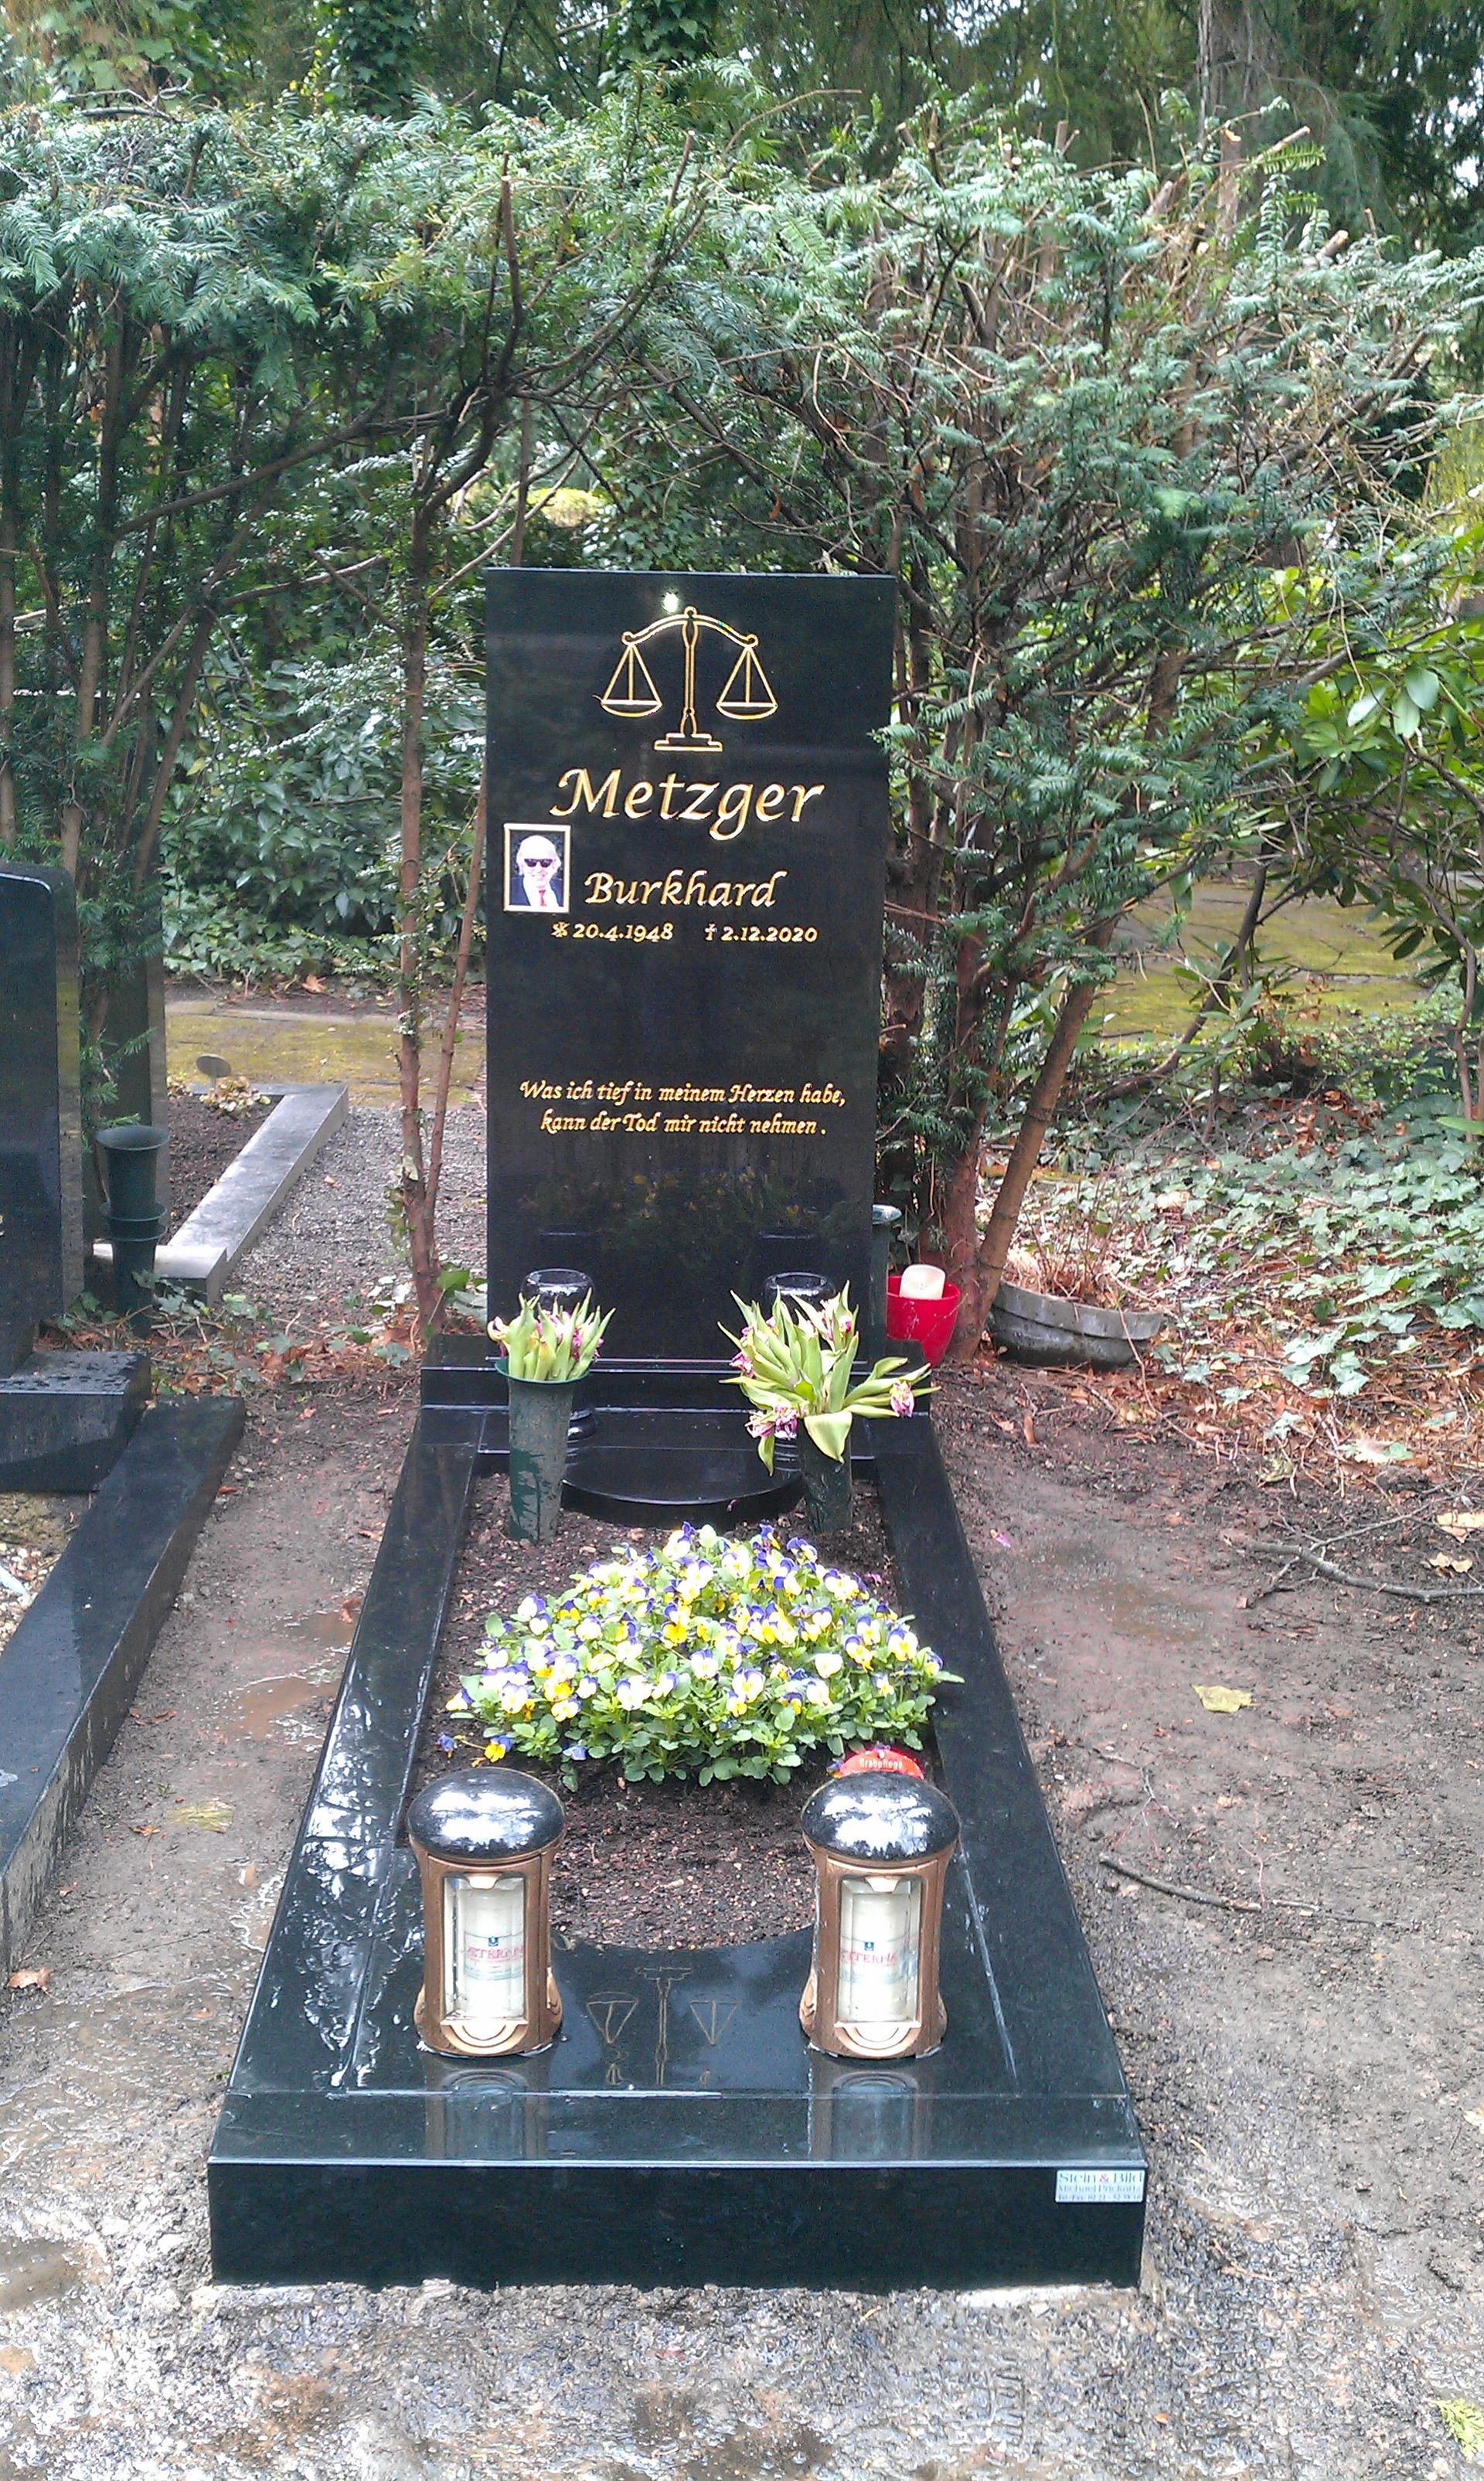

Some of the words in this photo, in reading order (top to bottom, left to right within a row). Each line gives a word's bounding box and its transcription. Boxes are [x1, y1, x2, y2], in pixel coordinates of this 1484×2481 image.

[548, 767, 825, 841] Metzger
[584, 869, 788, 907] Burkhard
[519, 1080, 563, 1099] Was
[566, 1080, 594, 1100] ich
[597, 1080, 635, 1106] tief
[633, 1081, 652, 1100] in
[659, 1083, 726, 1101] meinem
[727, 1084, 795, 1103] Herzen
[798, 1083, 846, 1107] habe,
[540, 1108, 587, 1134] kann
[590, 1110, 621, 1132] der
[622, 1111, 662, 1132] Tod
[663, 1114, 696, 1133] mir
[698, 1113, 746, 1134] nicht
[1059, 2173, 1097, 2183] Stein
[1099, 2172, 1110, 2184] &
[1113, 2170, 1143, 2183] Bild
